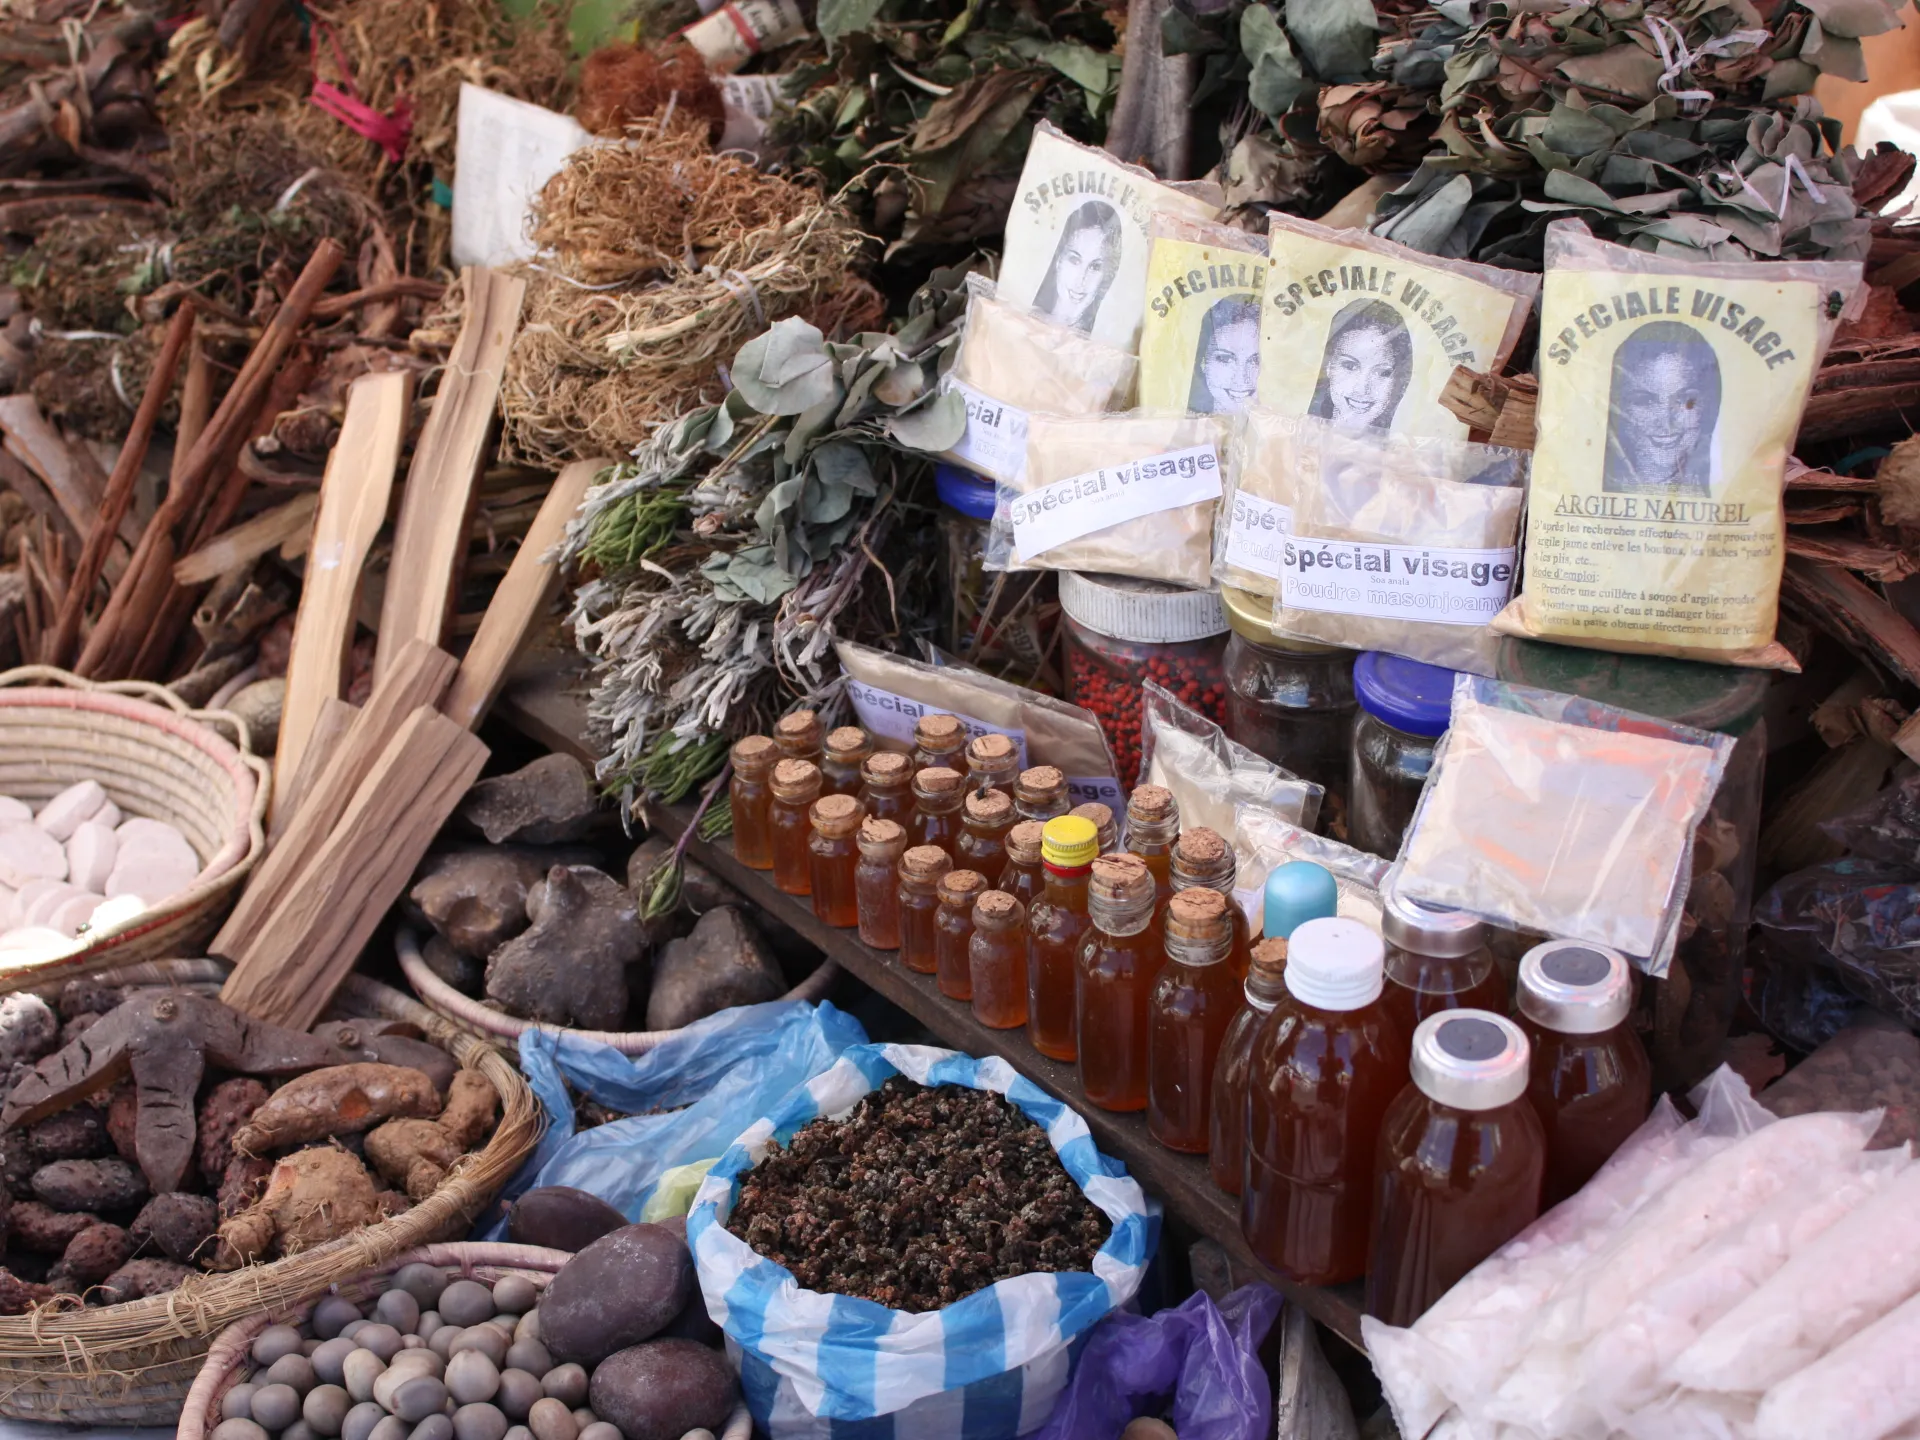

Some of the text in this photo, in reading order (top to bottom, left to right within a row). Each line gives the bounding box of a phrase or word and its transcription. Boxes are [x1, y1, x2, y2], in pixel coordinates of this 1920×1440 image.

[1024, 170, 1119, 214] SPECIALE
[1151, 263, 1265, 318] SPECIALE
[1274, 265, 1475, 367] SPECIALE VISAGE
[1547, 286, 1796, 370] SPECIALE VISAGE
[966, 400, 1003, 428] cial
[1012, 453, 1216, 526] Spécial visage
[1233, 499, 1286, 535] Spéc
[1554, 494, 1750, 523] ARGILE NATUREL
[1562, 538, 1588, 551] jaune
[1591, 540, 1624, 552] enlève
[1627, 541, 1641, 552] les
[1567, 522, 1580, 533] les
[1583, 524, 1636, 536] recherches
[1233, 531, 1280, 563] Poudr
[1284, 542, 1511, 587] Spécial visage
[1370, 574, 1410, 587] Soa anala
[1286, 577, 1507, 614] Poudre masonjoany
[1541, 583, 1756, 606] Prendre une cuillère à soupe d'argile poudre
[1572, 616, 1580, 626] la
[1611, 619, 1651, 630] obtenue
[1653, 622, 1712, 635] directement
[1577, 604, 1589, 613] un
[1592, 605, 1610, 616] peu
[1613, 604, 1641, 616] d'eau
[1643, 606, 1653, 616] et
[1656, 607, 1702, 621] mélanger
[851, 684, 924, 718] pécial
[1068, 783, 1117, 800] age
